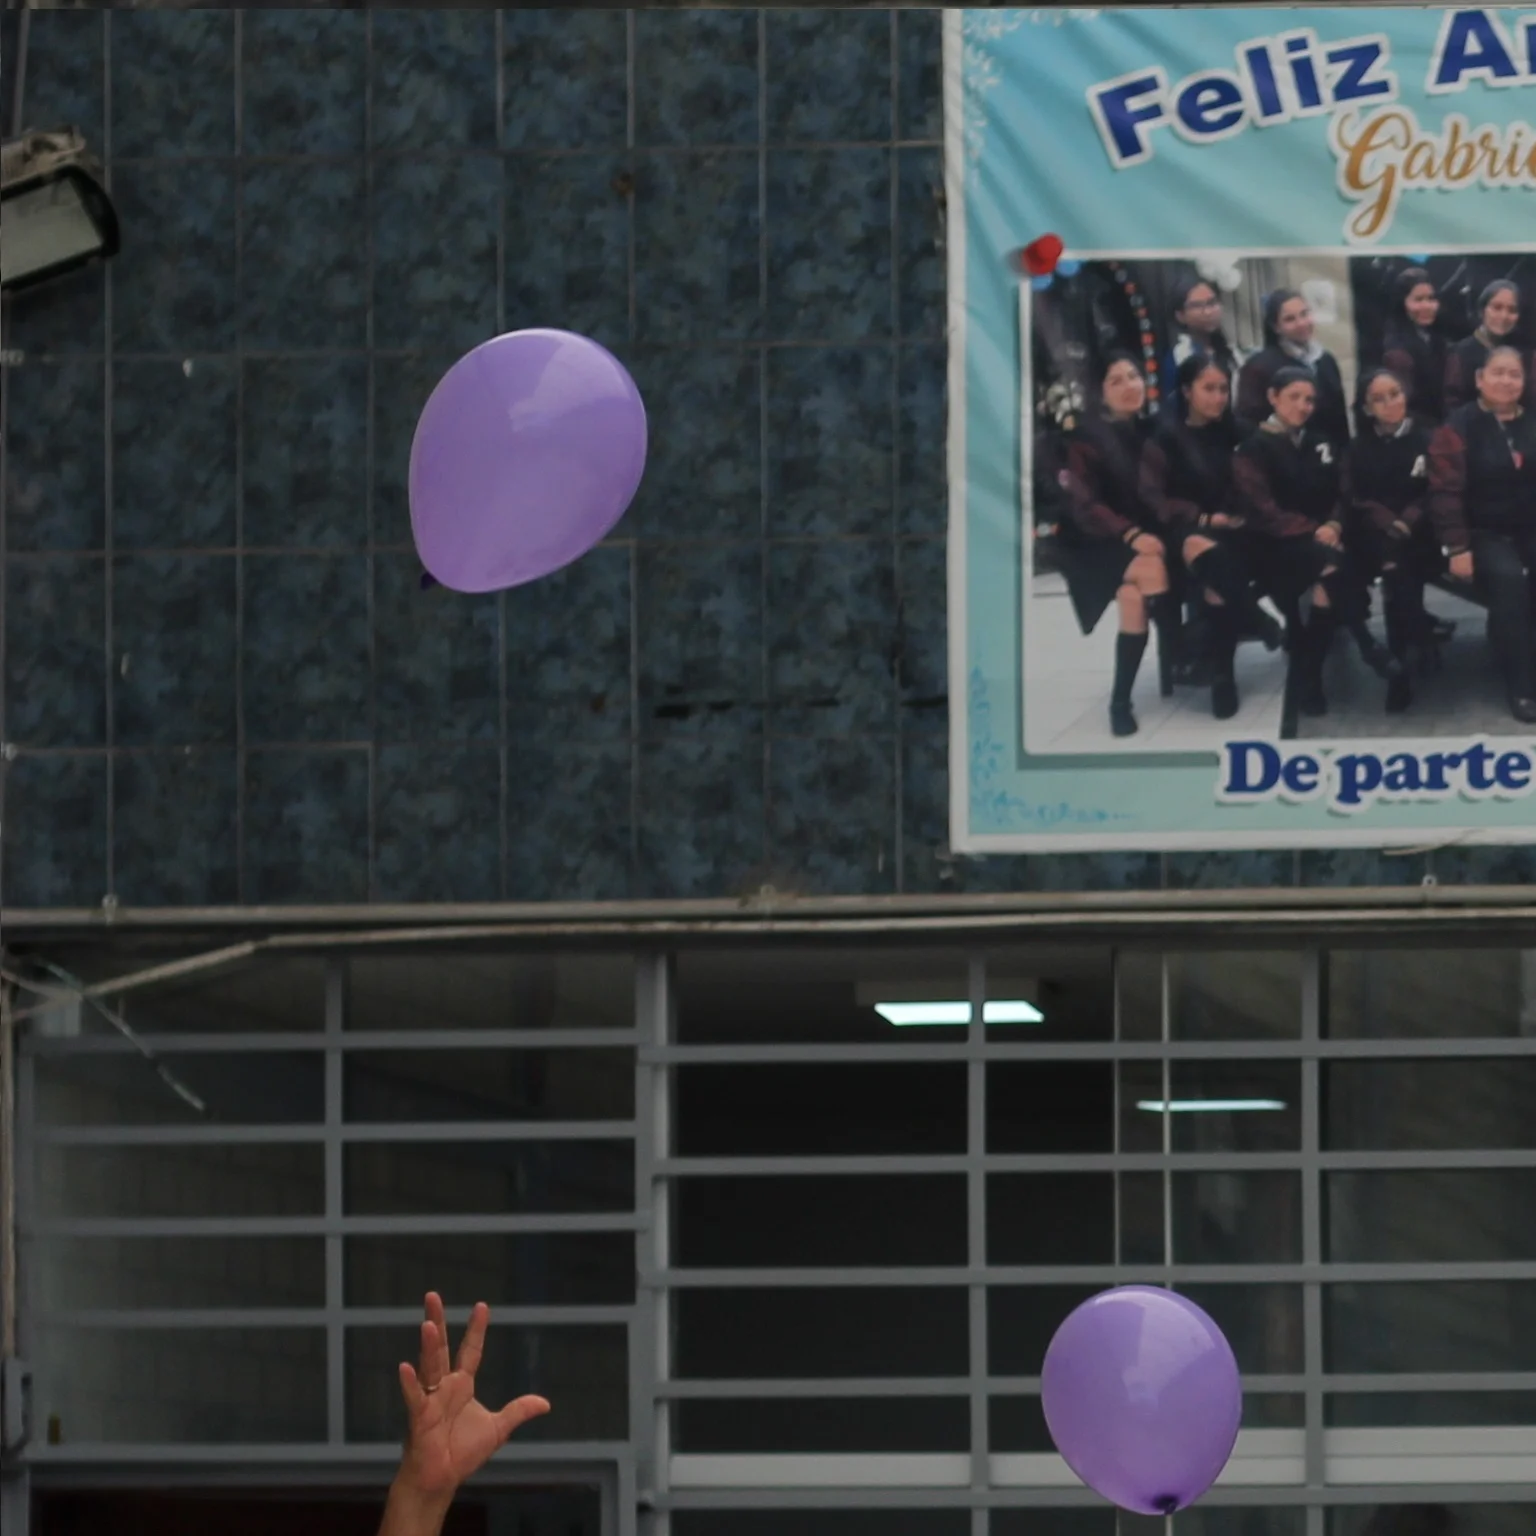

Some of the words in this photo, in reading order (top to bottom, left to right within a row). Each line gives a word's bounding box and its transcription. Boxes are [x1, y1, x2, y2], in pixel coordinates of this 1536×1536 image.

[1096, 35, 1390, 158] Feliz
[1224, 741, 1318, 794] De
[1334, 744, 1530, 804] parte
